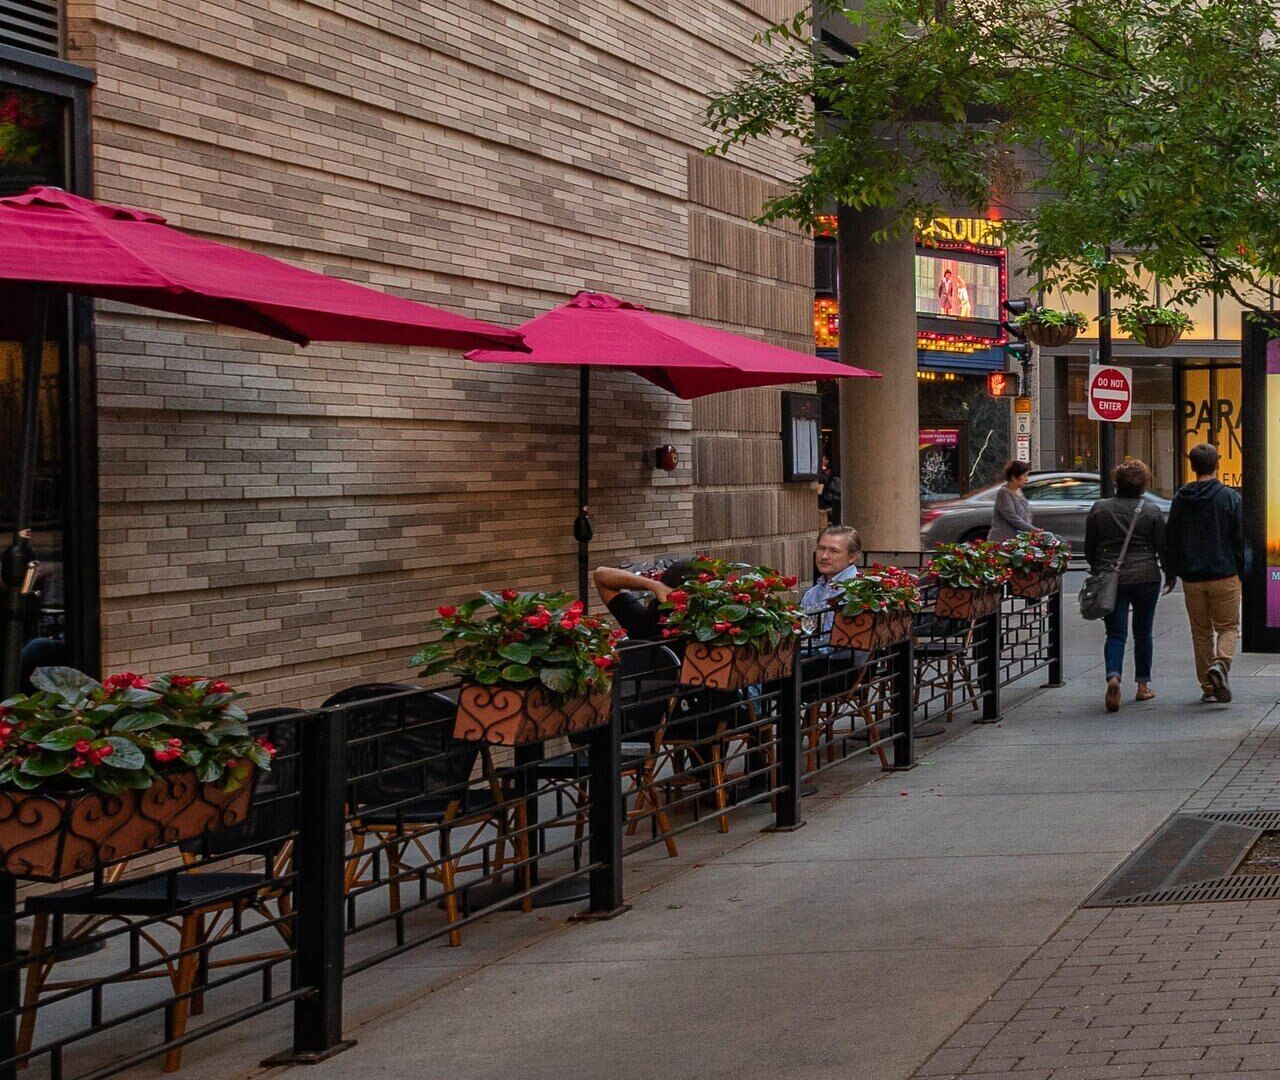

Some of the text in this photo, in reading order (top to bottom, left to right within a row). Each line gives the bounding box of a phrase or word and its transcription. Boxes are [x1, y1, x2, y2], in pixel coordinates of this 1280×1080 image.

[1097, 377, 1124, 388] DO NOT
[1099, 400, 1122, 411] ENTER
